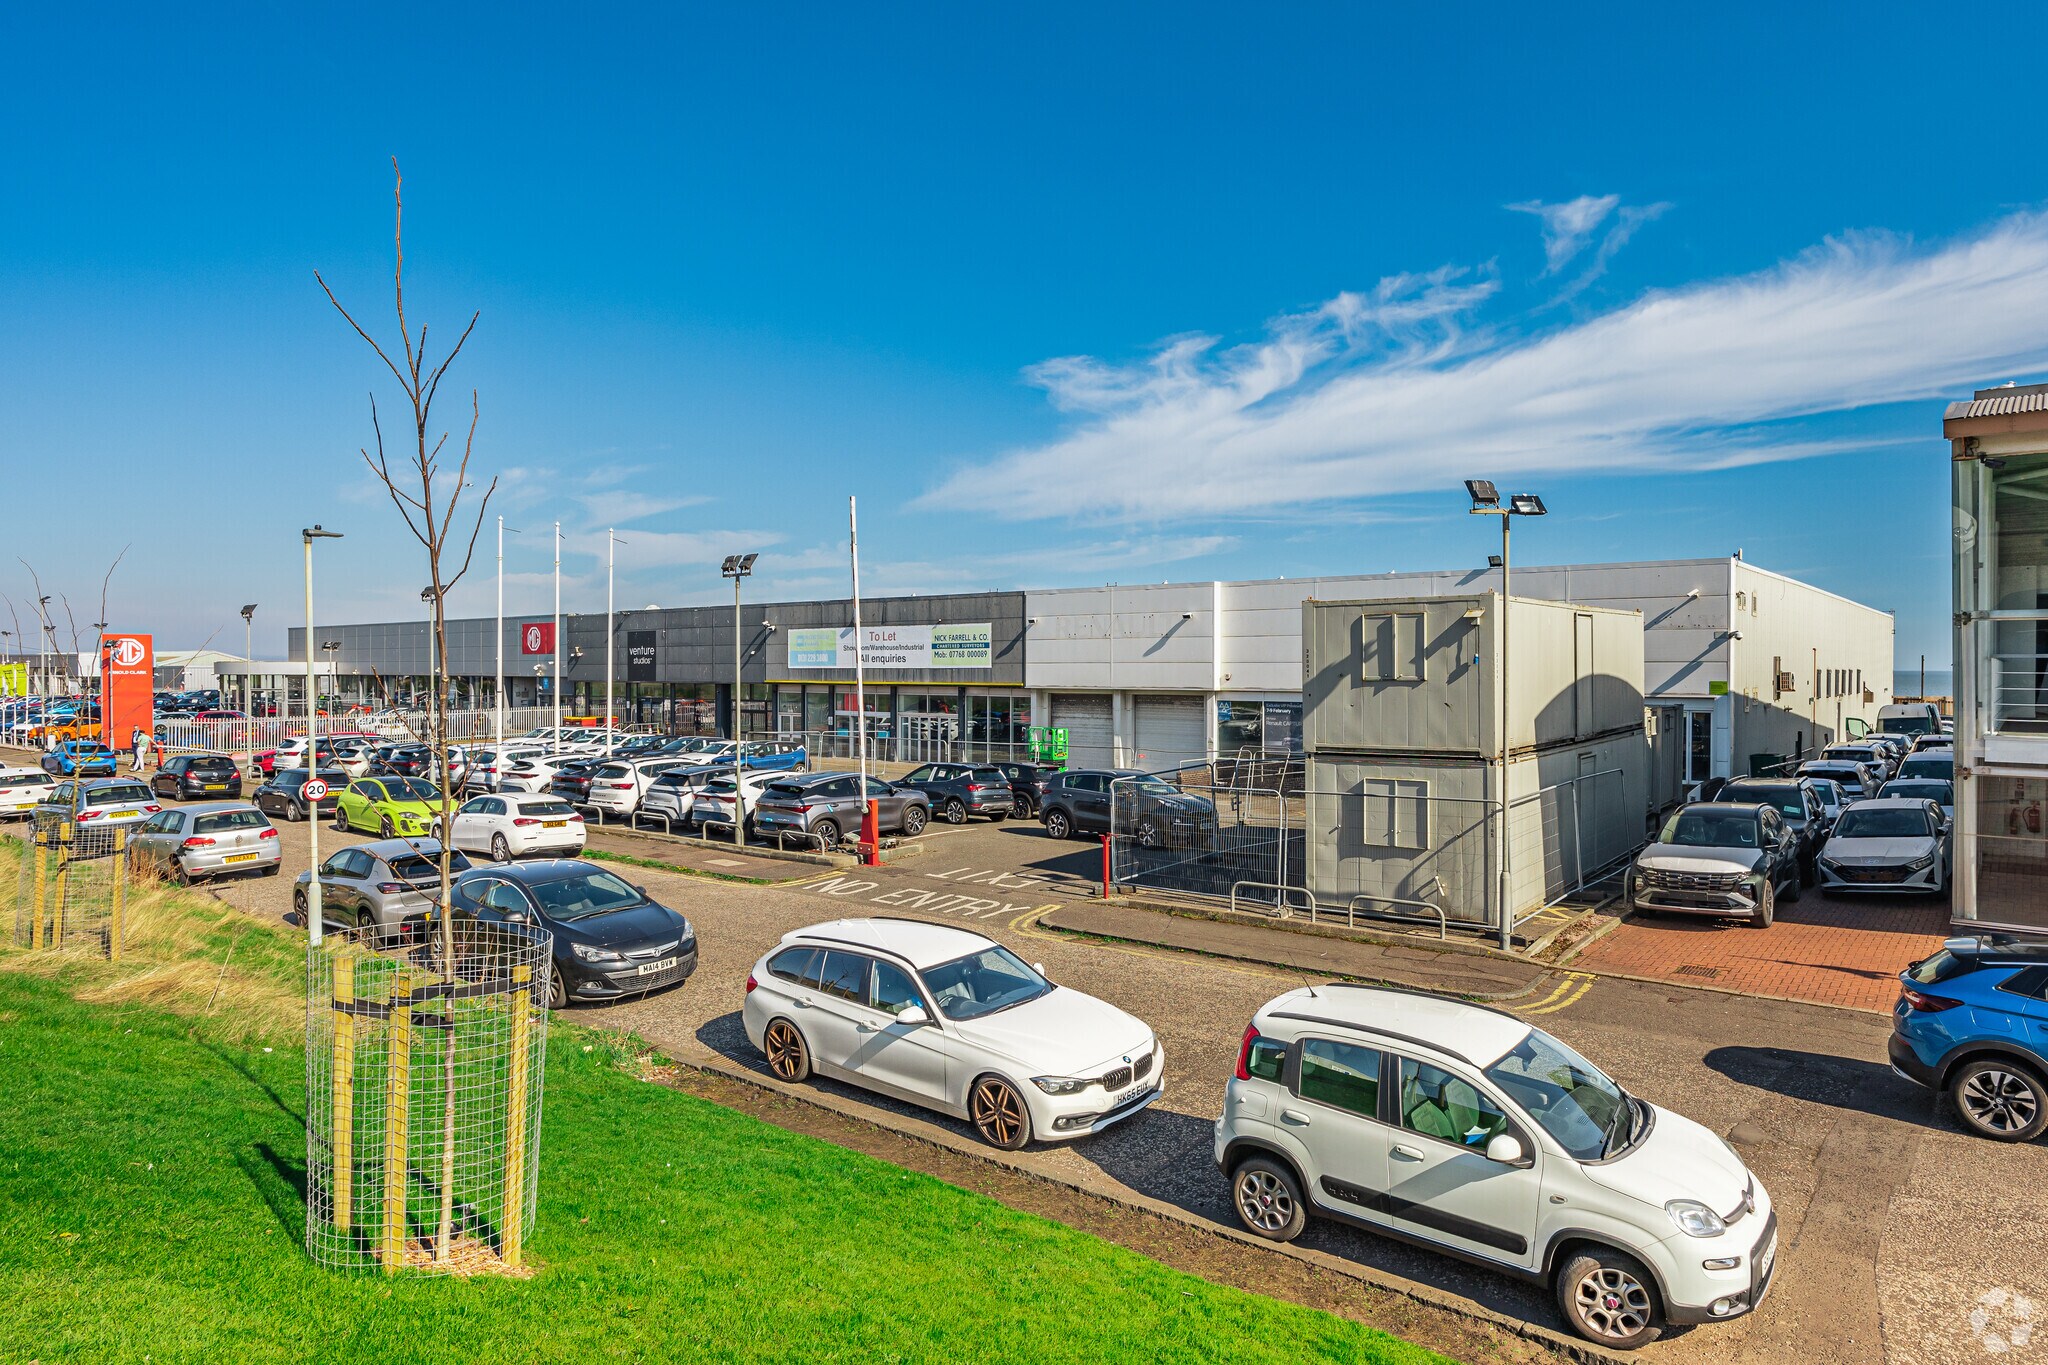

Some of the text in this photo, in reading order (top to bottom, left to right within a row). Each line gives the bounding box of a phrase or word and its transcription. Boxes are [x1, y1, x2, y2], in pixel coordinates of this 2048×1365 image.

[869, 631, 896, 641] To Let
[948, 633, 971, 641] FARRELL
[973, 633, 977, 641] &
[629, 645, 655, 656] venture
[948, 650, 966, 658] 07768
[861, 653, 907, 666] All enquiries
[308, 785, 325, 795] 20
[925, 867, 1043, 889] EXIT
[802, 877, 1031, 919] NO ENTRY
[1117, 1080, 1149, 1105] HK65 EUX
